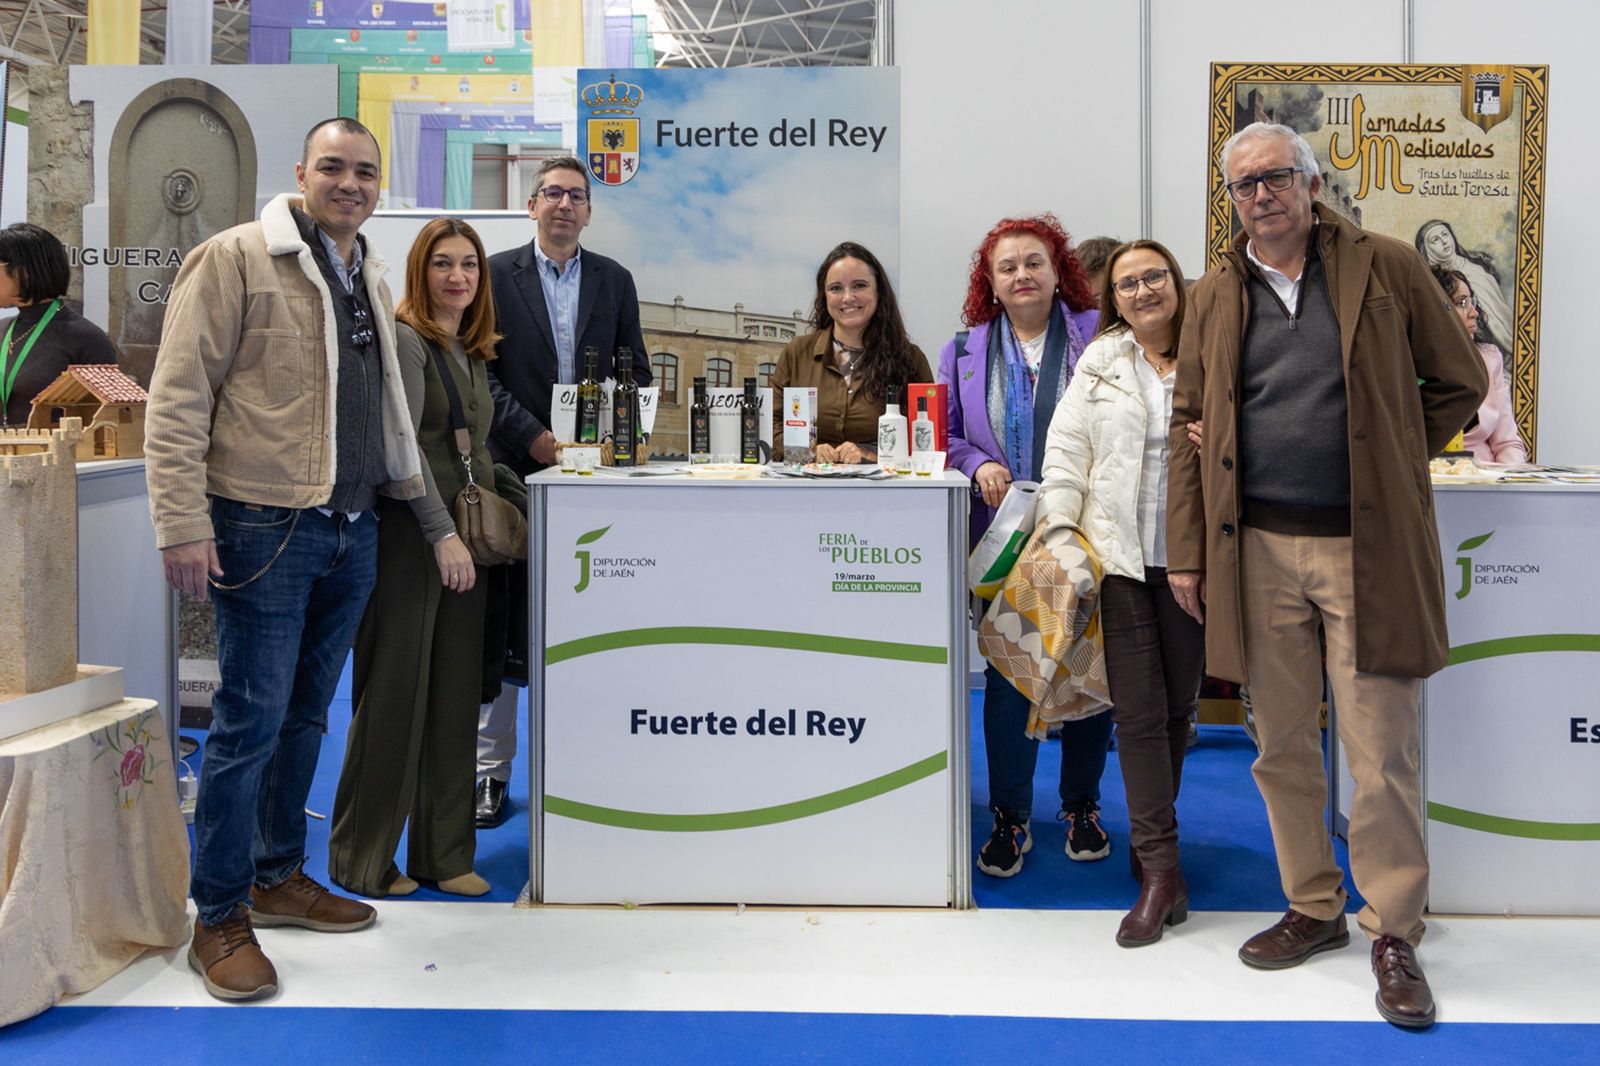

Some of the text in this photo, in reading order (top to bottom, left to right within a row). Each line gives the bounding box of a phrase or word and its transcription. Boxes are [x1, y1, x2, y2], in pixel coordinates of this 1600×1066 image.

[1326, 97, 1350, 125] III
[656, 118, 888, 153] Fuerte del Rey
[1329, 93, 1446, 171] Jornadas
[1354, 135, 1495, 200] Medievales
[1417, 167, 1511, 180] Tras las huellas de
[1418, 180, 1511, 198] Santa Teresa
[66, 246, 182, 267] IGUERA
[819, 533, 858, 546] FERIA
[593, 557, 656, 567] DIPUTACIÓN
[831, 546, 922, 564] PUEBLOS
[593, 568, 635, 578] DE JAÉN
[835, 572, 876, 581] 19/marzo
[1474, 564, 1540, 574] DIPUTACIÓN
[835, 582, 919, 592] DÍA DE LA PROVINCIA
[1474, 575, 1518, 584] DE JAÉN
[630, 708, 867, 745] Fuerte del Rey
